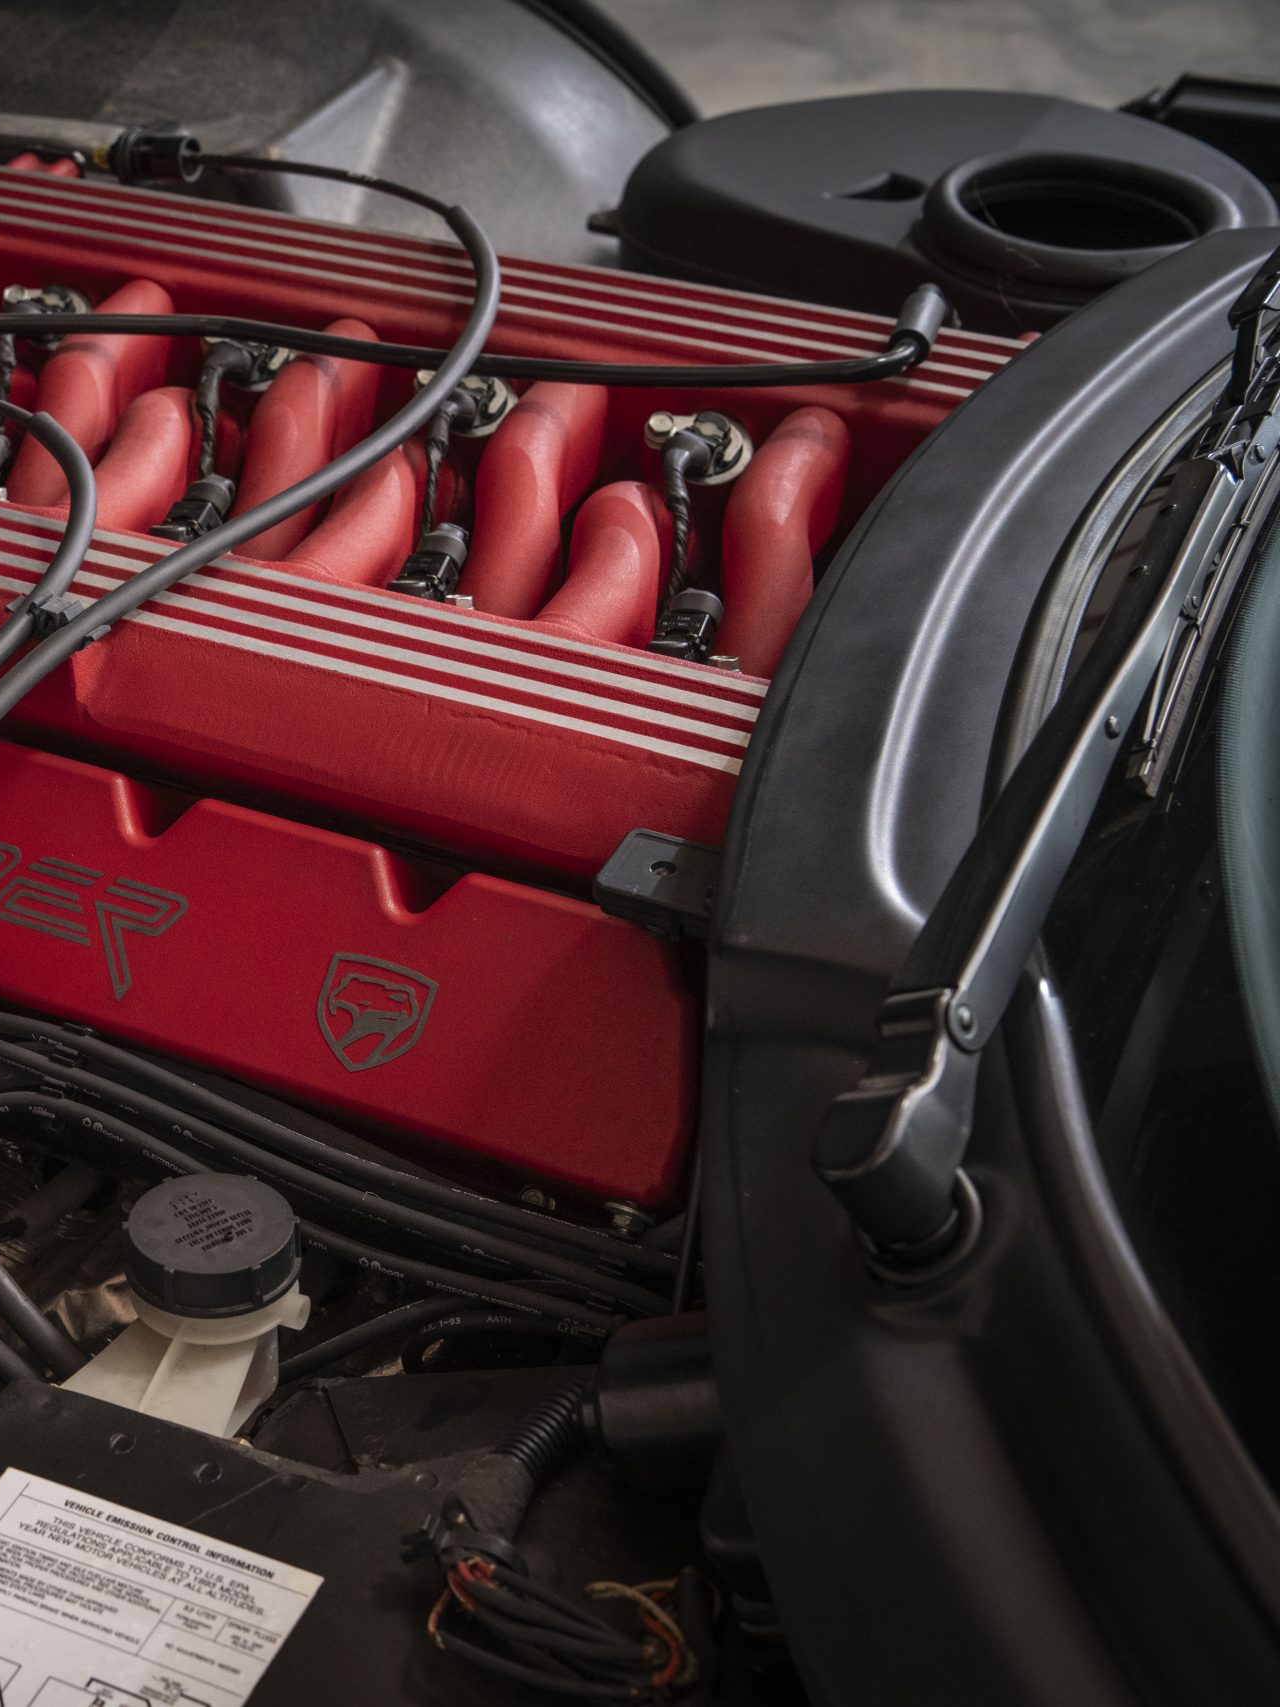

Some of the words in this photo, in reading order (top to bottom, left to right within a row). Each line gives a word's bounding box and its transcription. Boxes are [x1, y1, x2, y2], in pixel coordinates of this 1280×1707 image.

[18, 1522, 45, 1536] YEAR
[47, 1532, 72, 1546] NEW
[74, 1542, 113, 1560] MOTOR
[115, 1557, 167, 1579] VEHICLES
[168, 1576, 181, 1585] AT
[184, 1581, 203, 1593] ALL
[35, 1520, 107, 1549] REGULATIONS
[108, 1545, 170, 1571] APPLICABLE
[175, 1569, 189, 1578] TO
[218, 1585, 255, 1602] MODEL
[52, 1517, 75, 1529] THIS
[78, 1526, 122, 1546] VEHICLE
[124, 1542, 184, 1568] CONFORMS
[188, 1565, 202, 1574] TO
[229, 1579, 250, 1591] EPA
[64, 1499, 103, 1518] VEHICLE
[105, 1514, 153, 1535] EMISSION
[156, 1532, 202, 1552] CONTROL
[205, 1549, 275, 1578] INFORMATION
